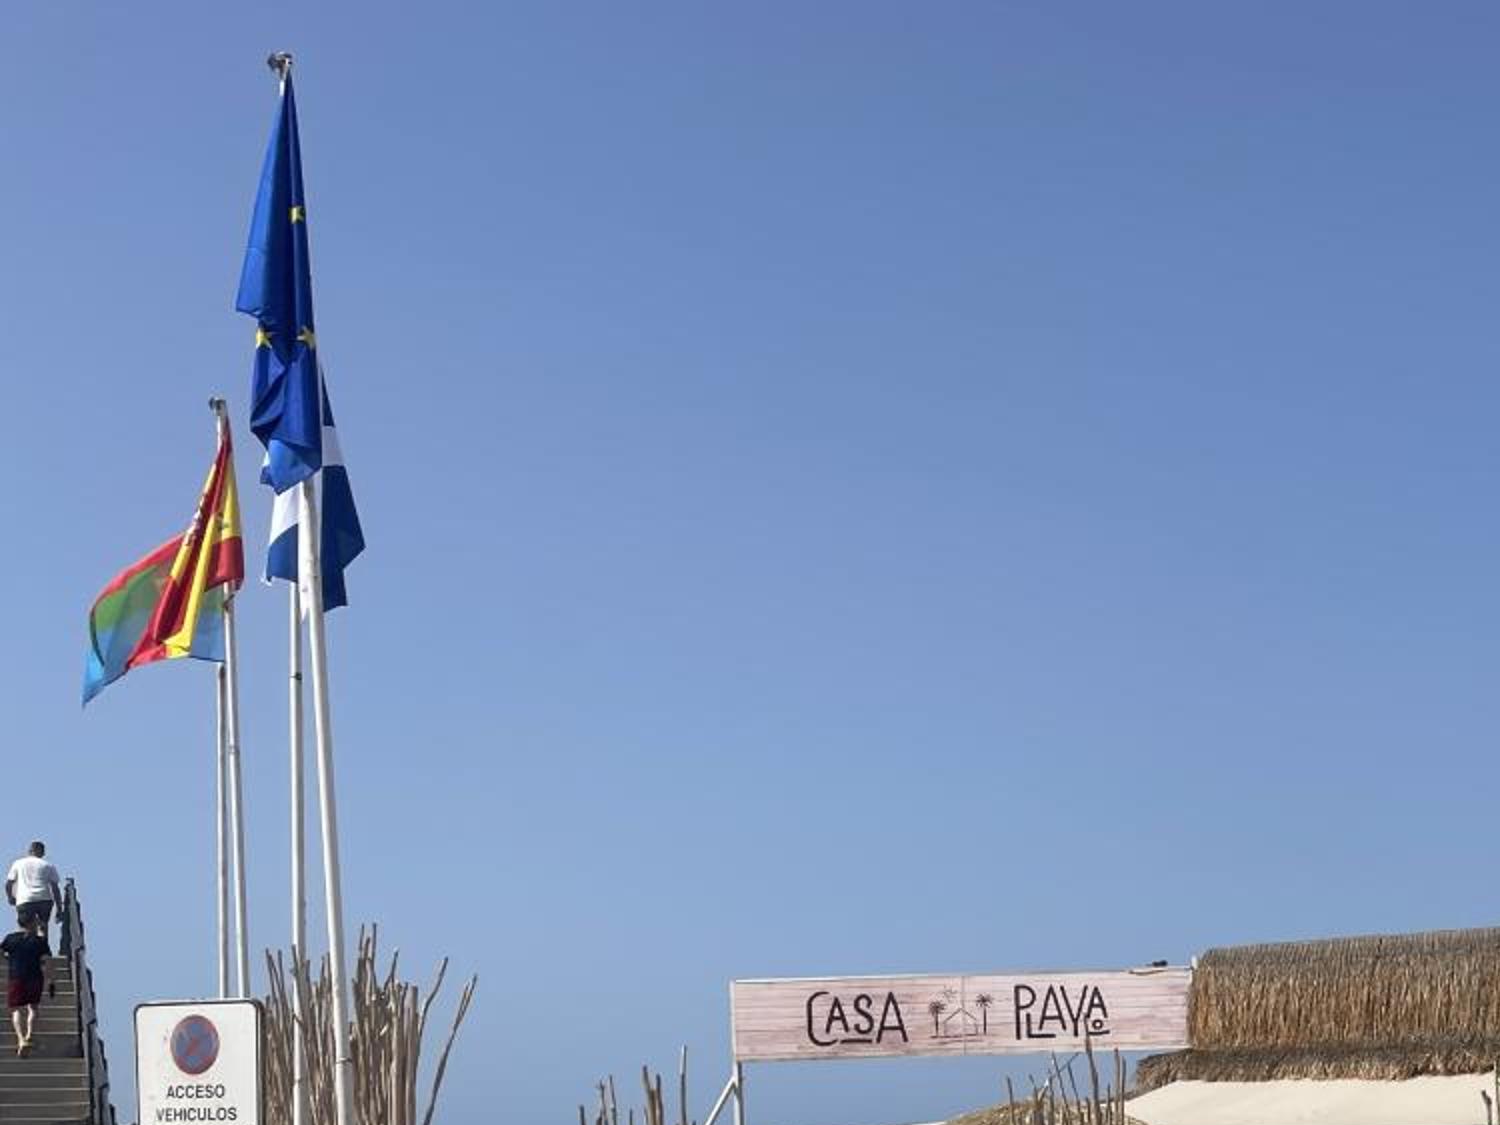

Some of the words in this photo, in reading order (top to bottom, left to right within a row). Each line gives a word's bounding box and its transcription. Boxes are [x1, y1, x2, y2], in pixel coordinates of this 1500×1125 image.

[806, 991, 909, 1046] CASA
[166, 1084, 226, 1099] ACCESO
[156, 1107, 238, 1122] VEHICULOS
